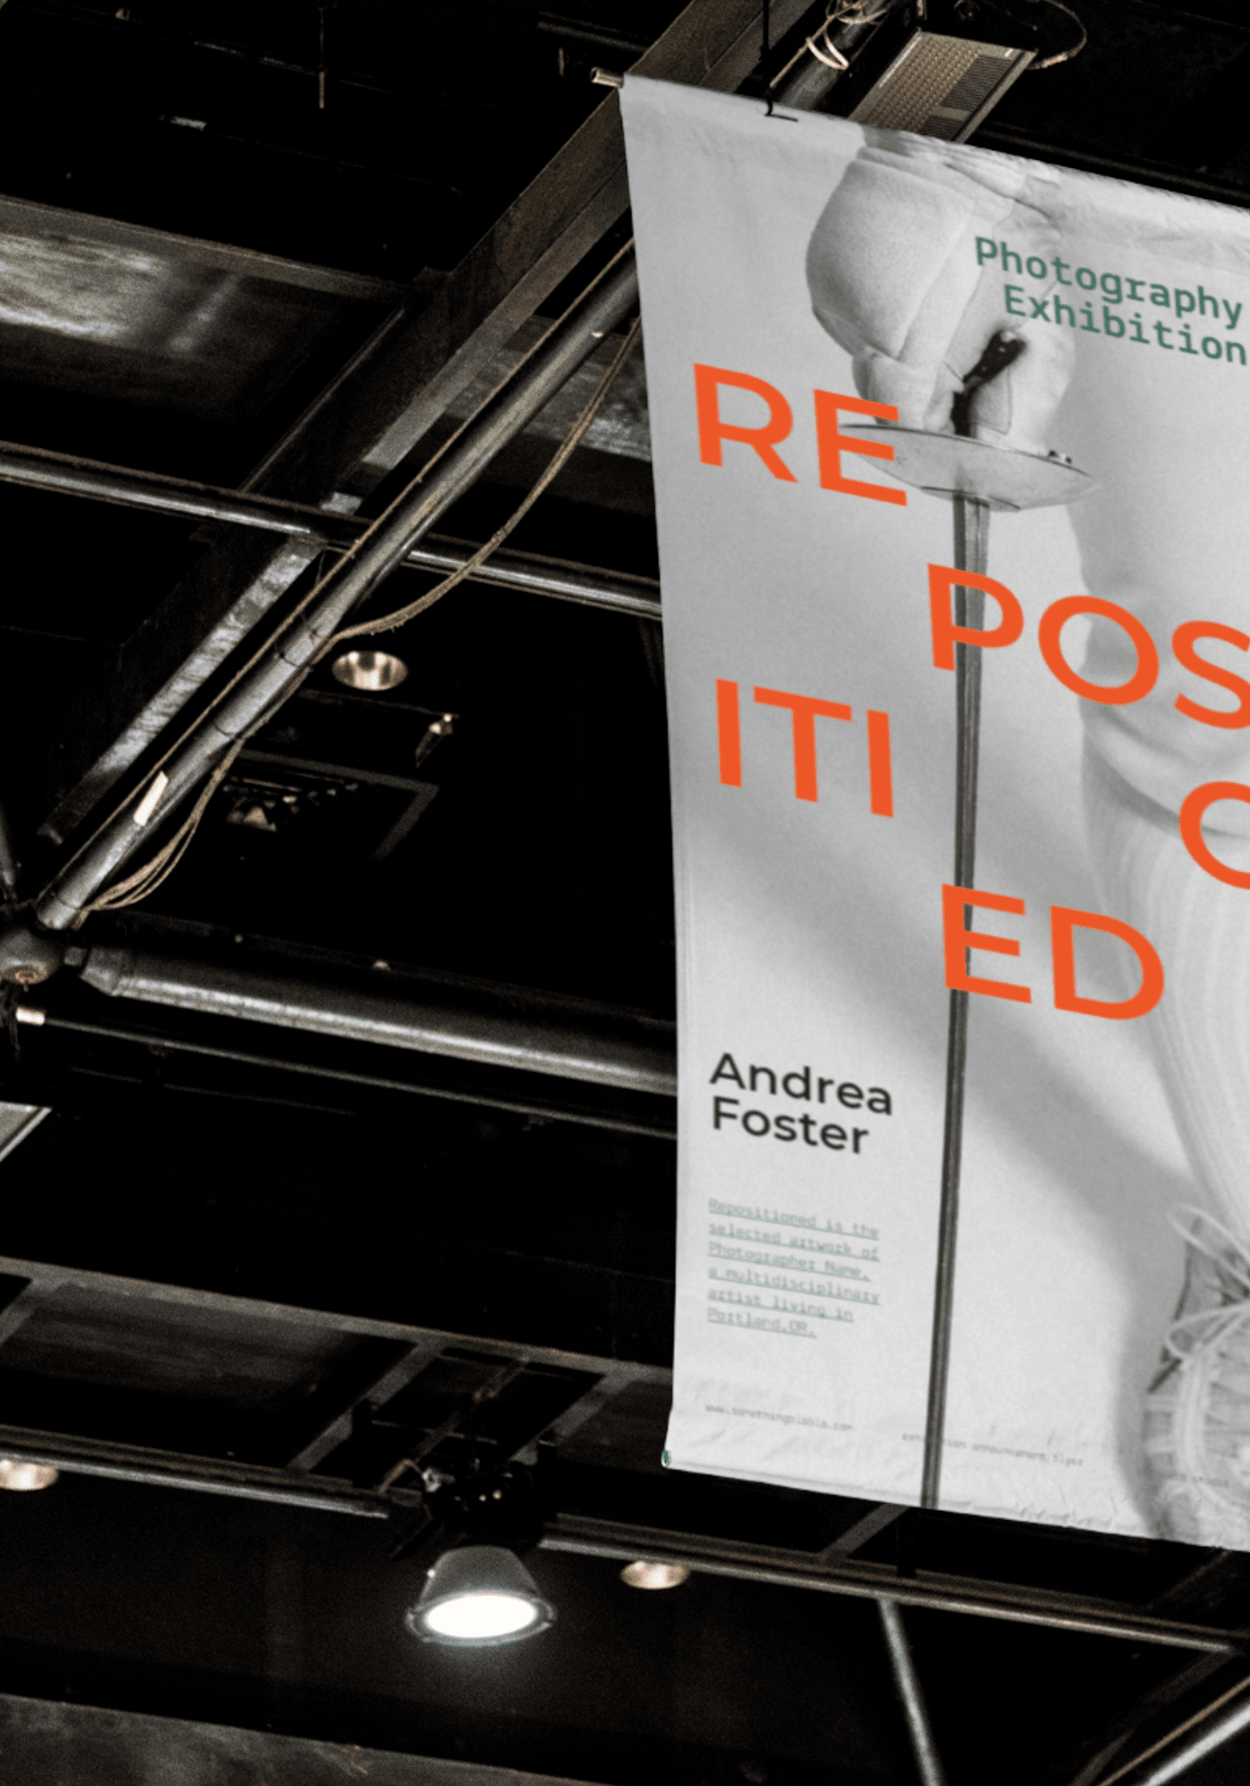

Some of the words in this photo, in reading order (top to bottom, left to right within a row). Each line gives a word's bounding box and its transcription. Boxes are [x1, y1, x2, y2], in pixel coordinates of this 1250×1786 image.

[976, 237, 1243, 330] Photography
[1004, 284, 1247, 366] Exhibition
[693, 363, 908, 507] RE
[716, 678, 894, 818] ITI
[941, 883, 1165, 1020] ED
[709, 1052, 892, 1116] Andrea
[713, 1095, 870, 1154] Foster
[708, 1198, 816, 1228] Repositioned
[826, 1218, 843, 1233] is
[853, 1223, 879, 1241] the
[708, 1222, 781, 1246] selected
[789, 1237, 852, 1257] artwork
[861, 1247, 880, 1262] of
[708, 1241, 816, 1272] Photographer
[708, 1288, 762, 1308] artist
[773, 1296, 826, 1319] living
[836, 1308, 854, 1324] in
[725, 1269, 880, 1306] multidisciplinary
